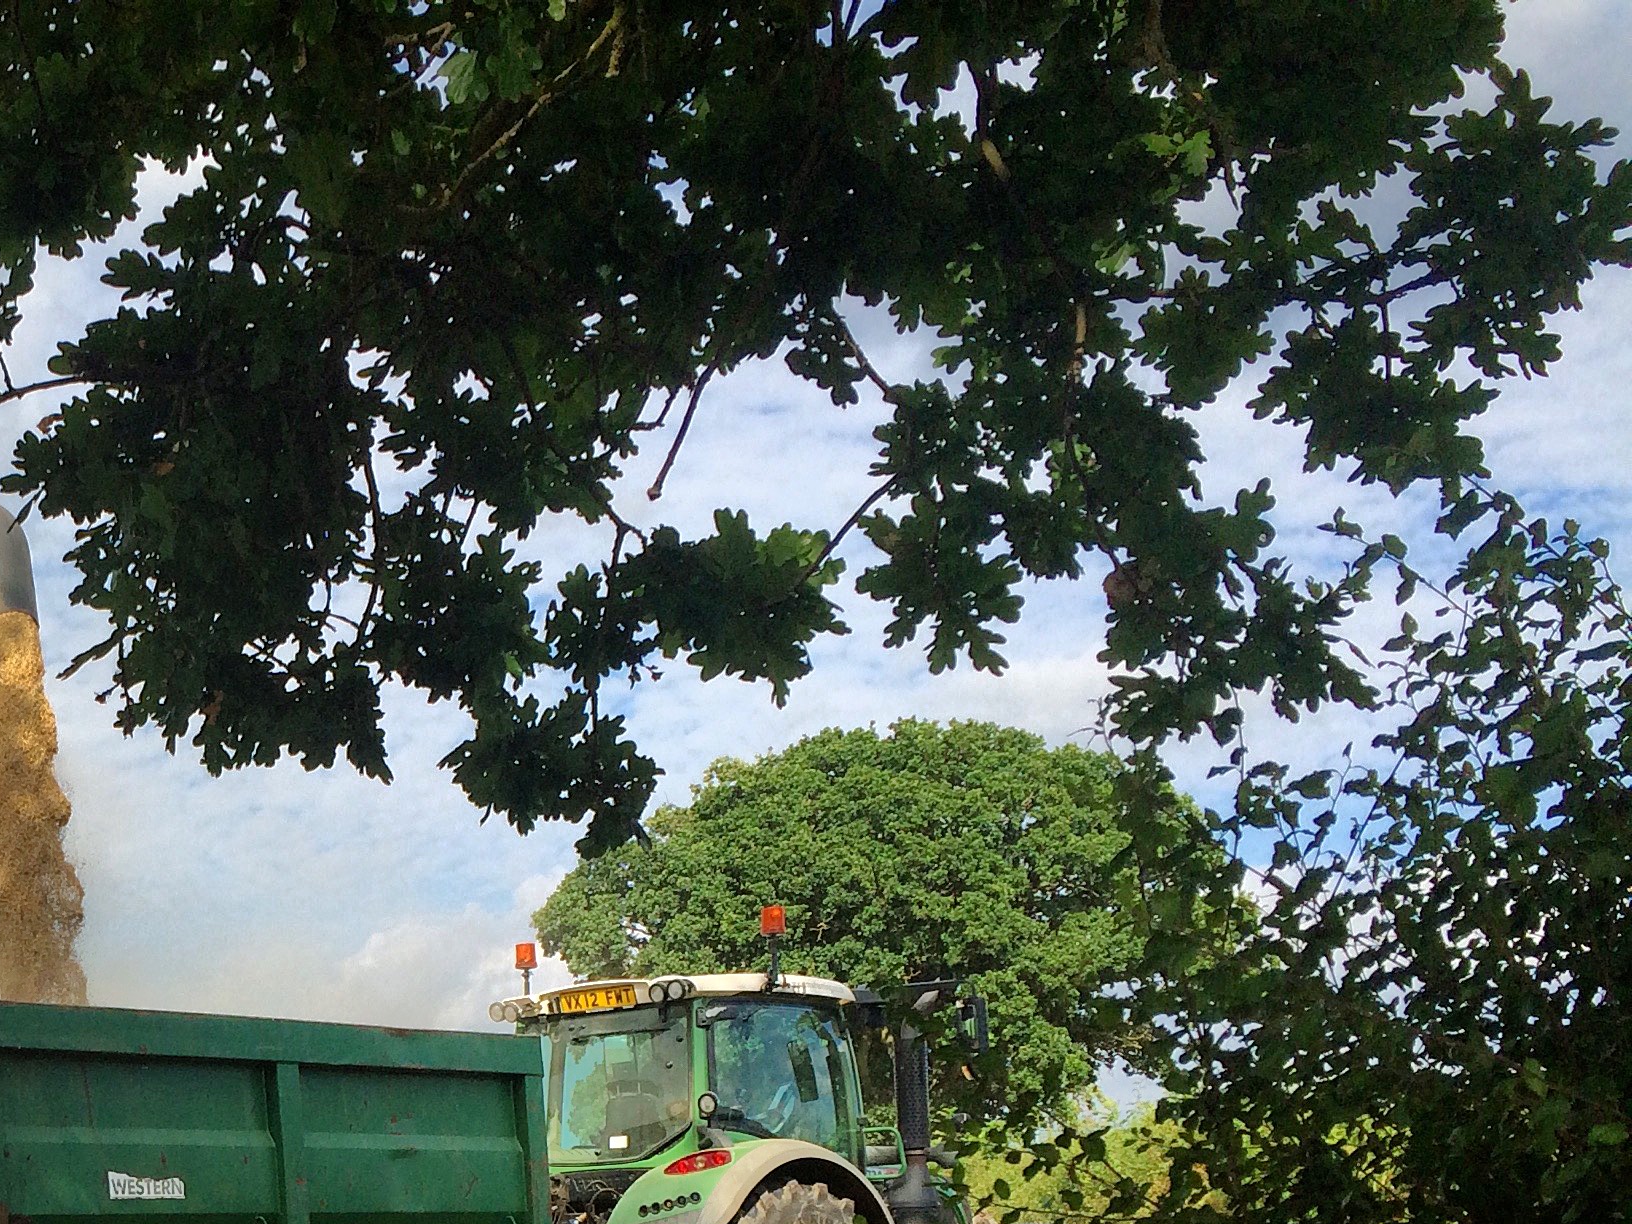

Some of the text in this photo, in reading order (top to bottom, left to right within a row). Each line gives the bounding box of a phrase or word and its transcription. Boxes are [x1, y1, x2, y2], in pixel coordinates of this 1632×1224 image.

[564, 988, 631, 1010] VX12 FWT
[111, 1178, 182, 1195] WESTERN
